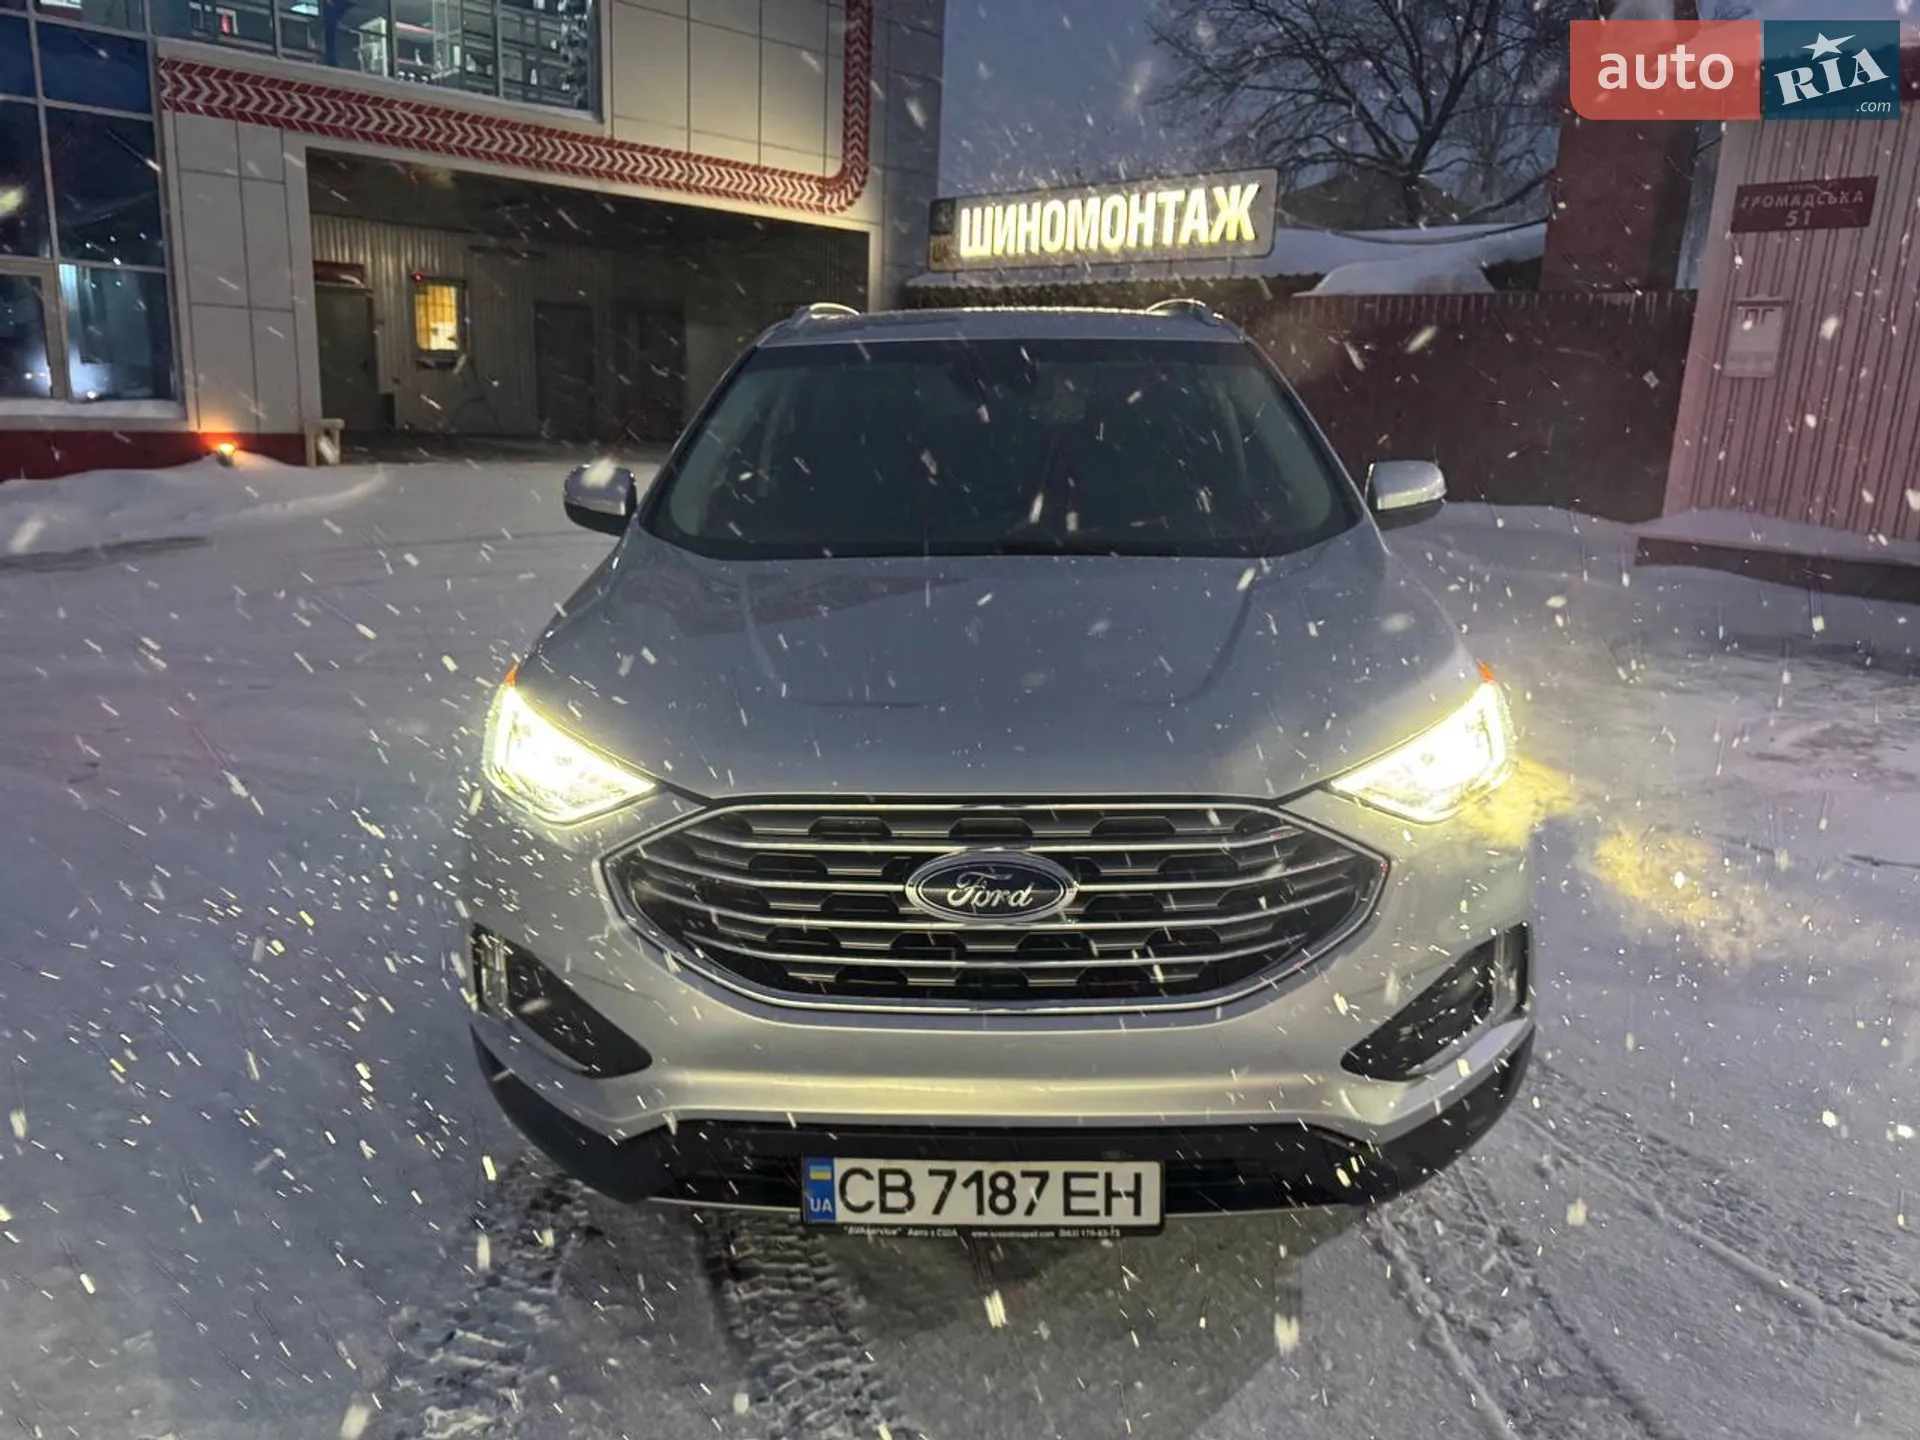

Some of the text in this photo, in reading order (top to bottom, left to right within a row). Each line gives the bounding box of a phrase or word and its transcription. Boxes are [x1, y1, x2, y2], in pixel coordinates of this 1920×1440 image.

[959, 182, 1259, 258] ШИНОМОНТАЖ
[1785, 209, 1812, 227] 51
[947, 871, 1034, 908] Ford
[809, 1198, 833, 1214] UA
[928, 1169, 1050, 1217] 7187
